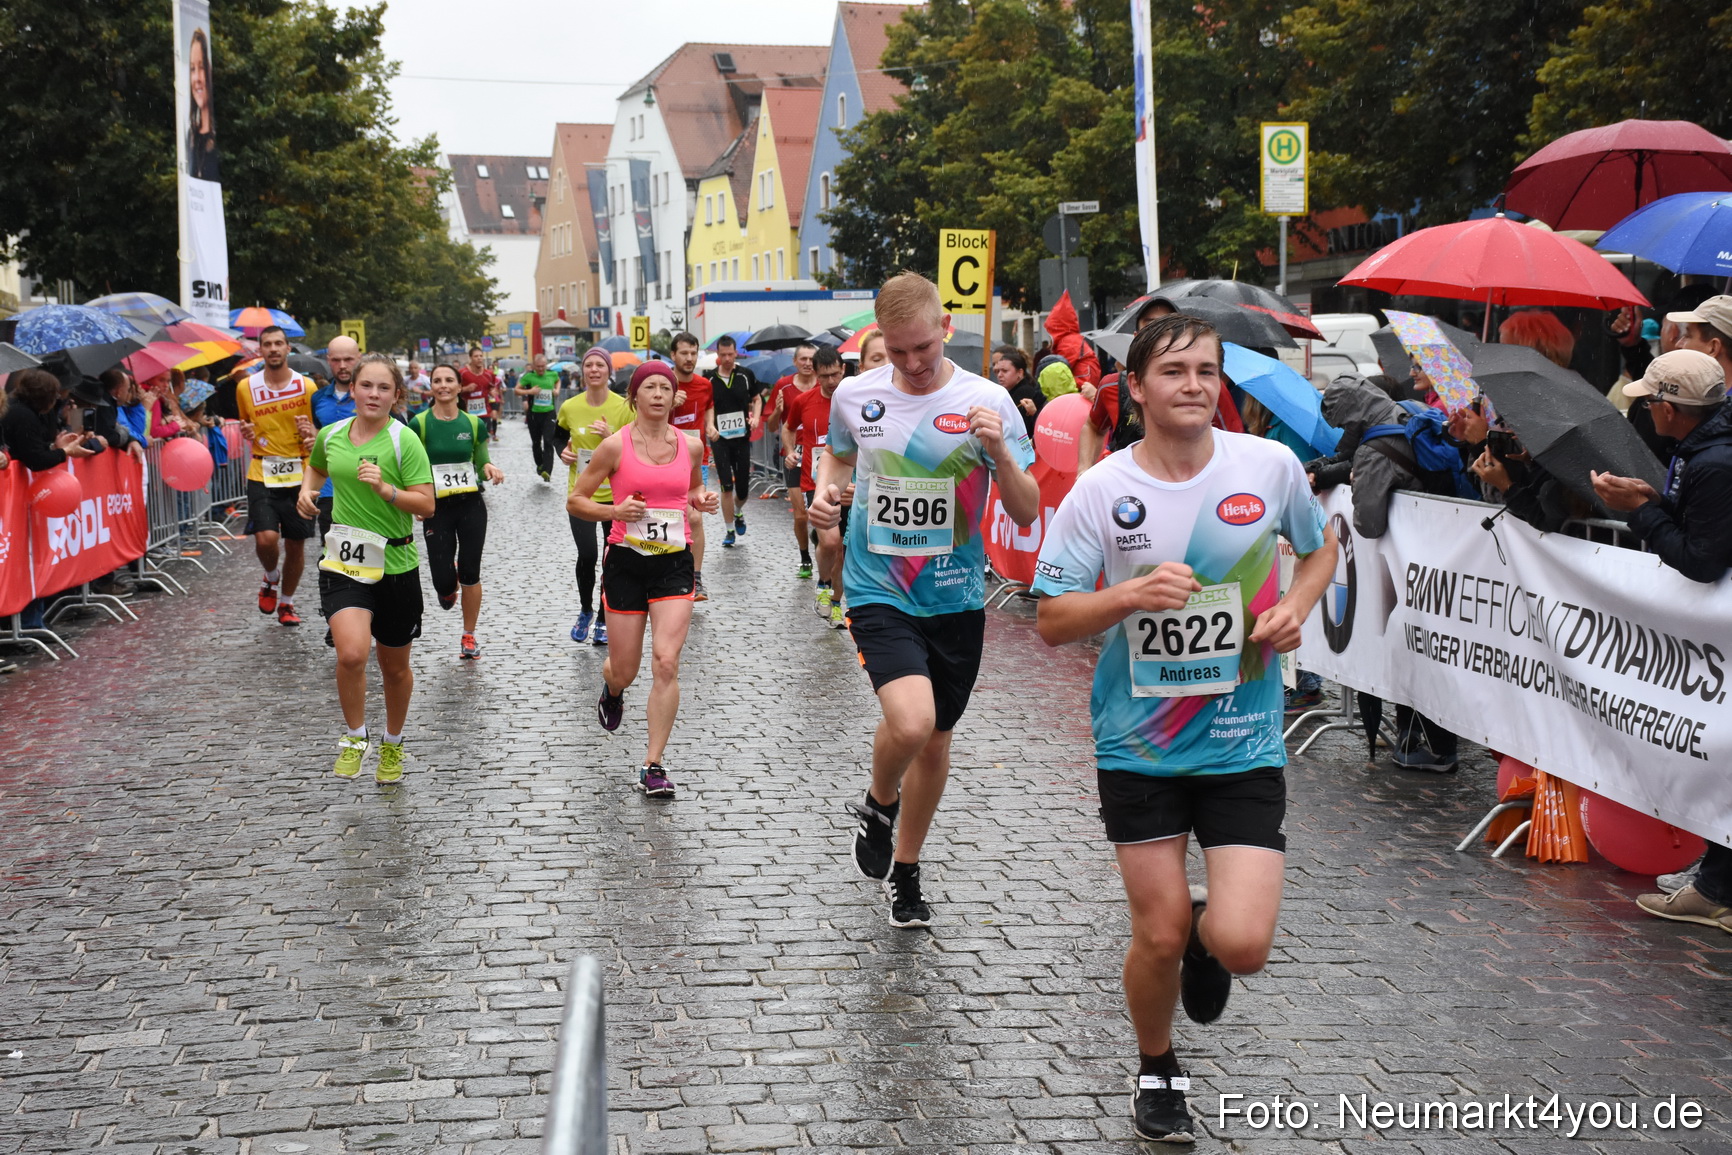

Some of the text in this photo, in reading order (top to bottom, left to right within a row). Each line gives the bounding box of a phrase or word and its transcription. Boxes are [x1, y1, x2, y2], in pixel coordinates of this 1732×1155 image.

[1276, 137, 1293, 157] H
[946, 233, 989, 249] Block
[952, 255, 980, 296] C
[635, 326, 645, 341] D
[255, 398, 308, 417] MAX BÖGL
[721, 417, 743, 430] 2712
[859, 425, 884, 433] PARTL
[939, 417, 967, 430] Hervis
[270, 461, 294, 475] 323
[443, 472, 469, 488] 314
[905, 480, 949, 491] BOCK
[876, 495, 947, 526] 2596
[1223, 501, 1261, 517] Hervis
[646, 522, 668, 541] 51
[892, 532, 928, 546] Martin
[1116, 533, 1151, 545] PARTL
[339, 540, 365, 563] 84
[1118, 542, 1152, 551] Neumarkt
[935, 555, 953, 569] 17.
[1405, 562, 1457, 618] BMW
[1138, 611, 1236, 656] 2622
[1160, 666, 1221, 682] Andreas
[1404, 622, 1460, 667] WENIGER
[1463, 640, 1560, 699] VERBRAUCH.
[1590, 687, 1708, 760] FAHRFREUDE.
[1216, 695, 1238, 713] 17.
[1211, 711, 1267, 725] Neumarkter
